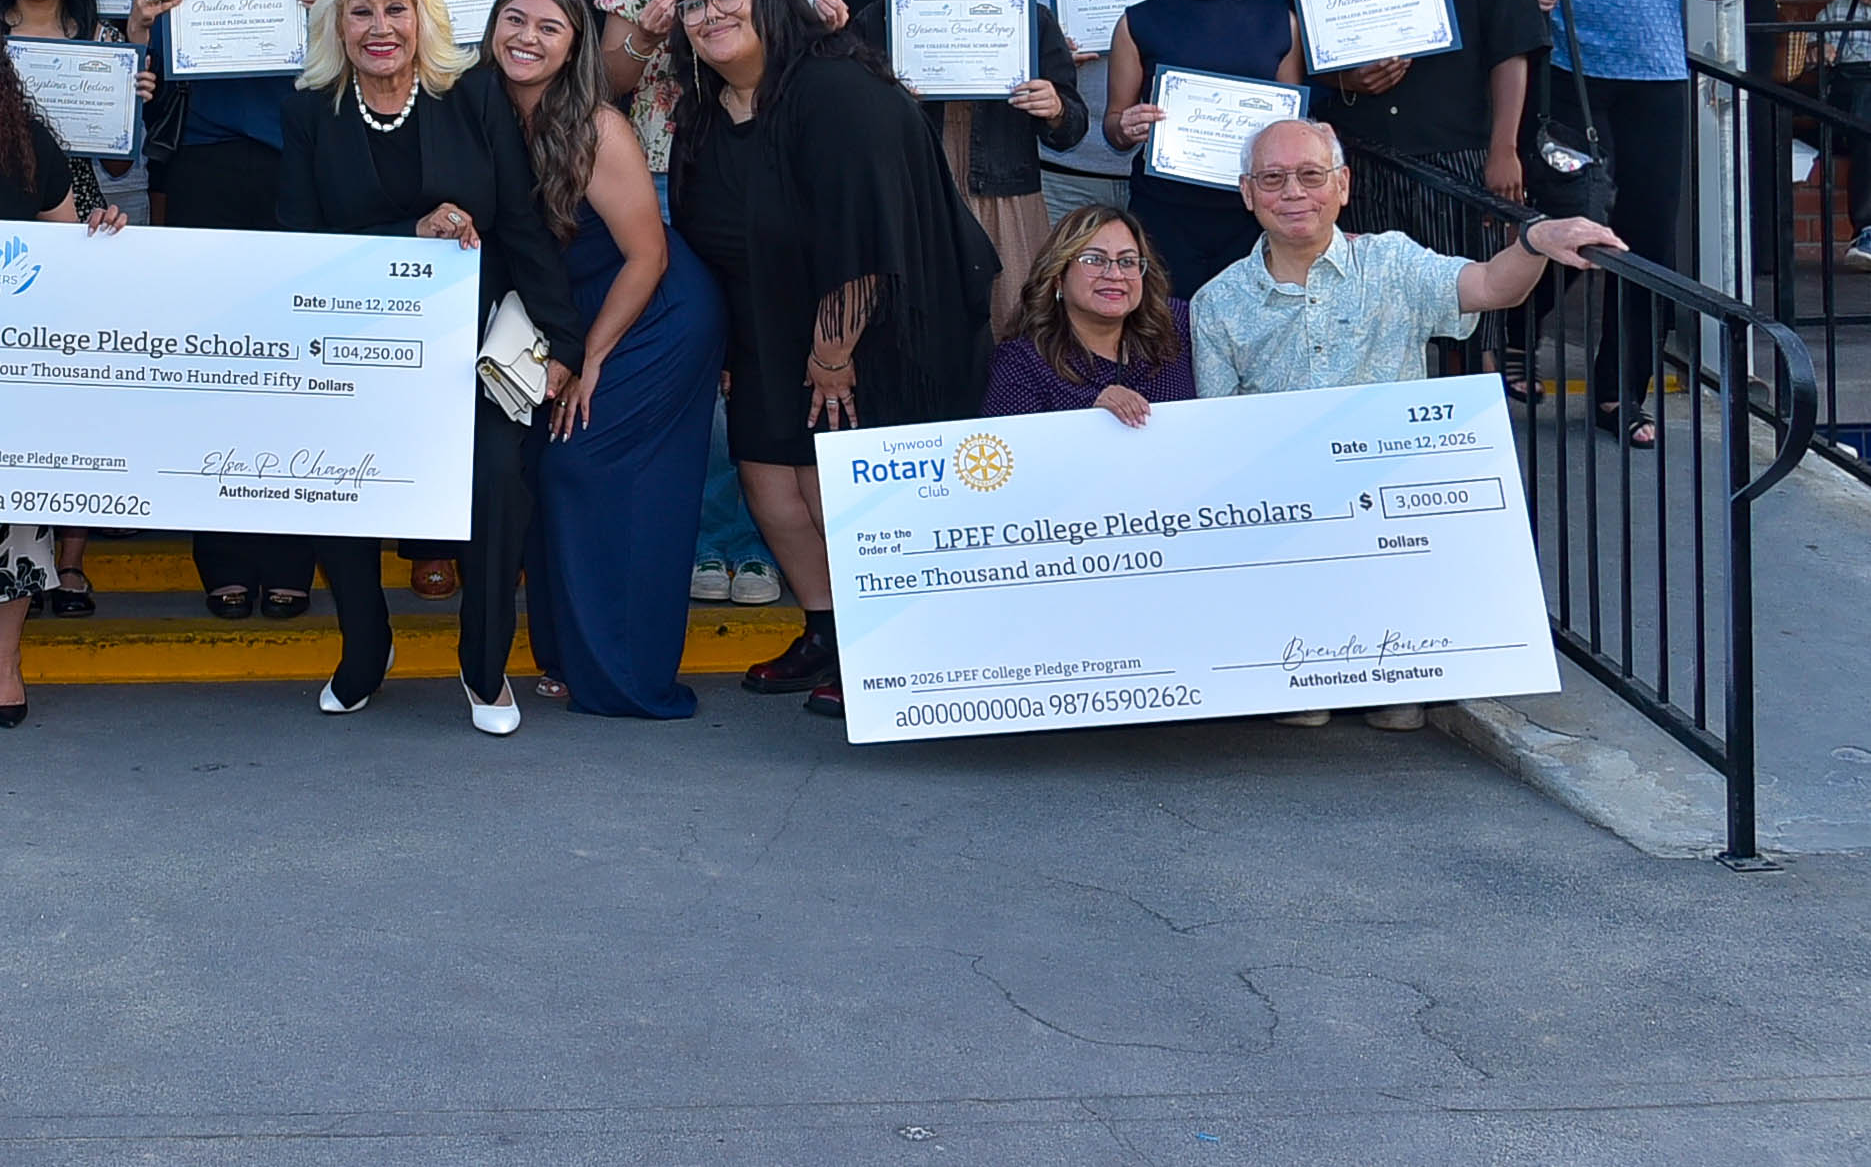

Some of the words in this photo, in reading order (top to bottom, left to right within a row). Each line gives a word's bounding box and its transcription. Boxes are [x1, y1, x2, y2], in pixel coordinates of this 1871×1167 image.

[192, 0, 235, 12] Pauline
[69, 79, 114, 94] Medina
[389, 262, 433, 278] 1234
[293, 295, 326, 309] Date
[331, 296, 362, 312] June
[365, 298, 386, 312] 12,
[389, 299, 421, 312] 2026
[1, 326, 91, 352] College
[97, 330, 178, 357] Pledge
[185, 334, 290, 358] Scholars
[309, 339, 321, 357] $
[332, 344, 414, 363] 104,250.00
[32, 362, 111, 380] Thousand
[115, 365, 145, 381] and
[150, 366, 182, 383] Two
[187, 369, 258, 385] Hundred
[263, 371, 301, 390] Fifty
[308, 379, 354, 393] Dollars
[1407, 403, 1454, 423] 1237
[882, 435, 943, 454] Lynwood
[1331, 440, 1368, 456] Date
[1377, 437, 1412, 454] June
[1415, 436, 1438, 450] 12,
[1440, 432, 1476, 447] 2026
[27, 451, 68, 468] Pledge
[71, 454, 126, 470] Program
[852, 454, 946, 485] Rotary
[219, 486, 289, 500] Authorized
[294, 489, 358, 504] Signature
[917, 484, 949, 499] Club
[1359, 492, 1373, 510] $
[1395, 489, 1469, 510] 3,000.00
[10, 492, 151, 516] 9876590262c
[933, 525, 996, 551] LPEF
[1002, 518, 1099, 547] College
[1104, 511, 1192, 541] Pledge
[1198, 498, 1313, 526] Scholars
[857, 532, 877, 543] Pay
[881, 532, 891, 540] to
[894, 529, 911, 539] the
[1377, 533, 1429, 549] Dollars
[858, 545, 887, 555] Order
[890, 543, 901, 553] of
[856, 569, 917, 592] Three
[922, 561, 1030, 587] Thousand
[1034, 557, 1076, 577] and
[1081, 549, 1164, 574] 00/100
[863, 676, 906, 690] MEMO
[910, 673, 944, 686] 2026
[947, 670, 978, 683] LPEF
[981, 666, 1031, 683] College
[1034, 662, 1079, 679] Pledge
[1083, 657, 1141, 675] Program
[1289, 671, 1367, 688] Authorized
[1371, 665, 1443, 684] Signature
[1050, 684, 1201, 716] 9876590262c
